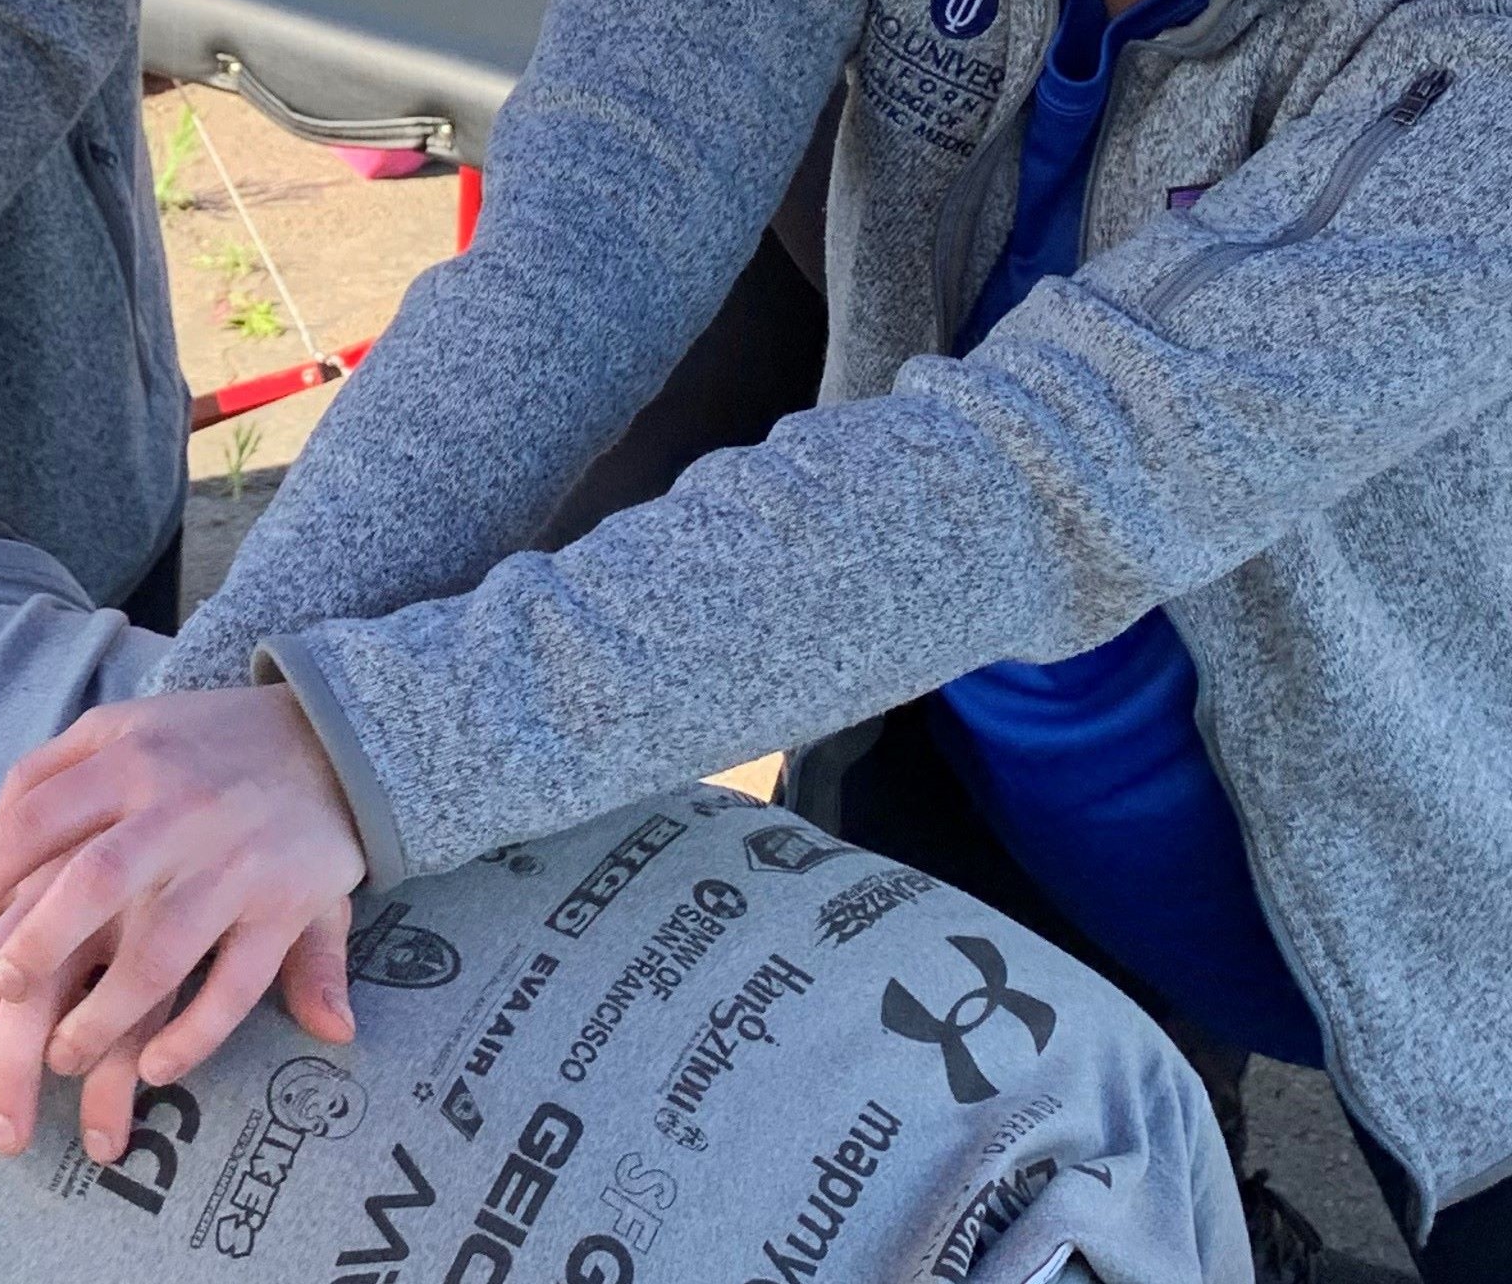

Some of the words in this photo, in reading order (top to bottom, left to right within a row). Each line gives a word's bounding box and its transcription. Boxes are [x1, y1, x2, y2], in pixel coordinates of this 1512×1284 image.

[589, 817, 682, 897] BIG
[555, 898, 601, 935] 5
[652, 903, 701, 951] SAN
[671, 915, 727, 972] BMW
[559, 945, 668, 1083] FRANCISCO
[649, 966, 683, 1003] OF
[666, 953, 816, 1114] Hangzhou
[744, 1100, 903, 1284] mapmy
